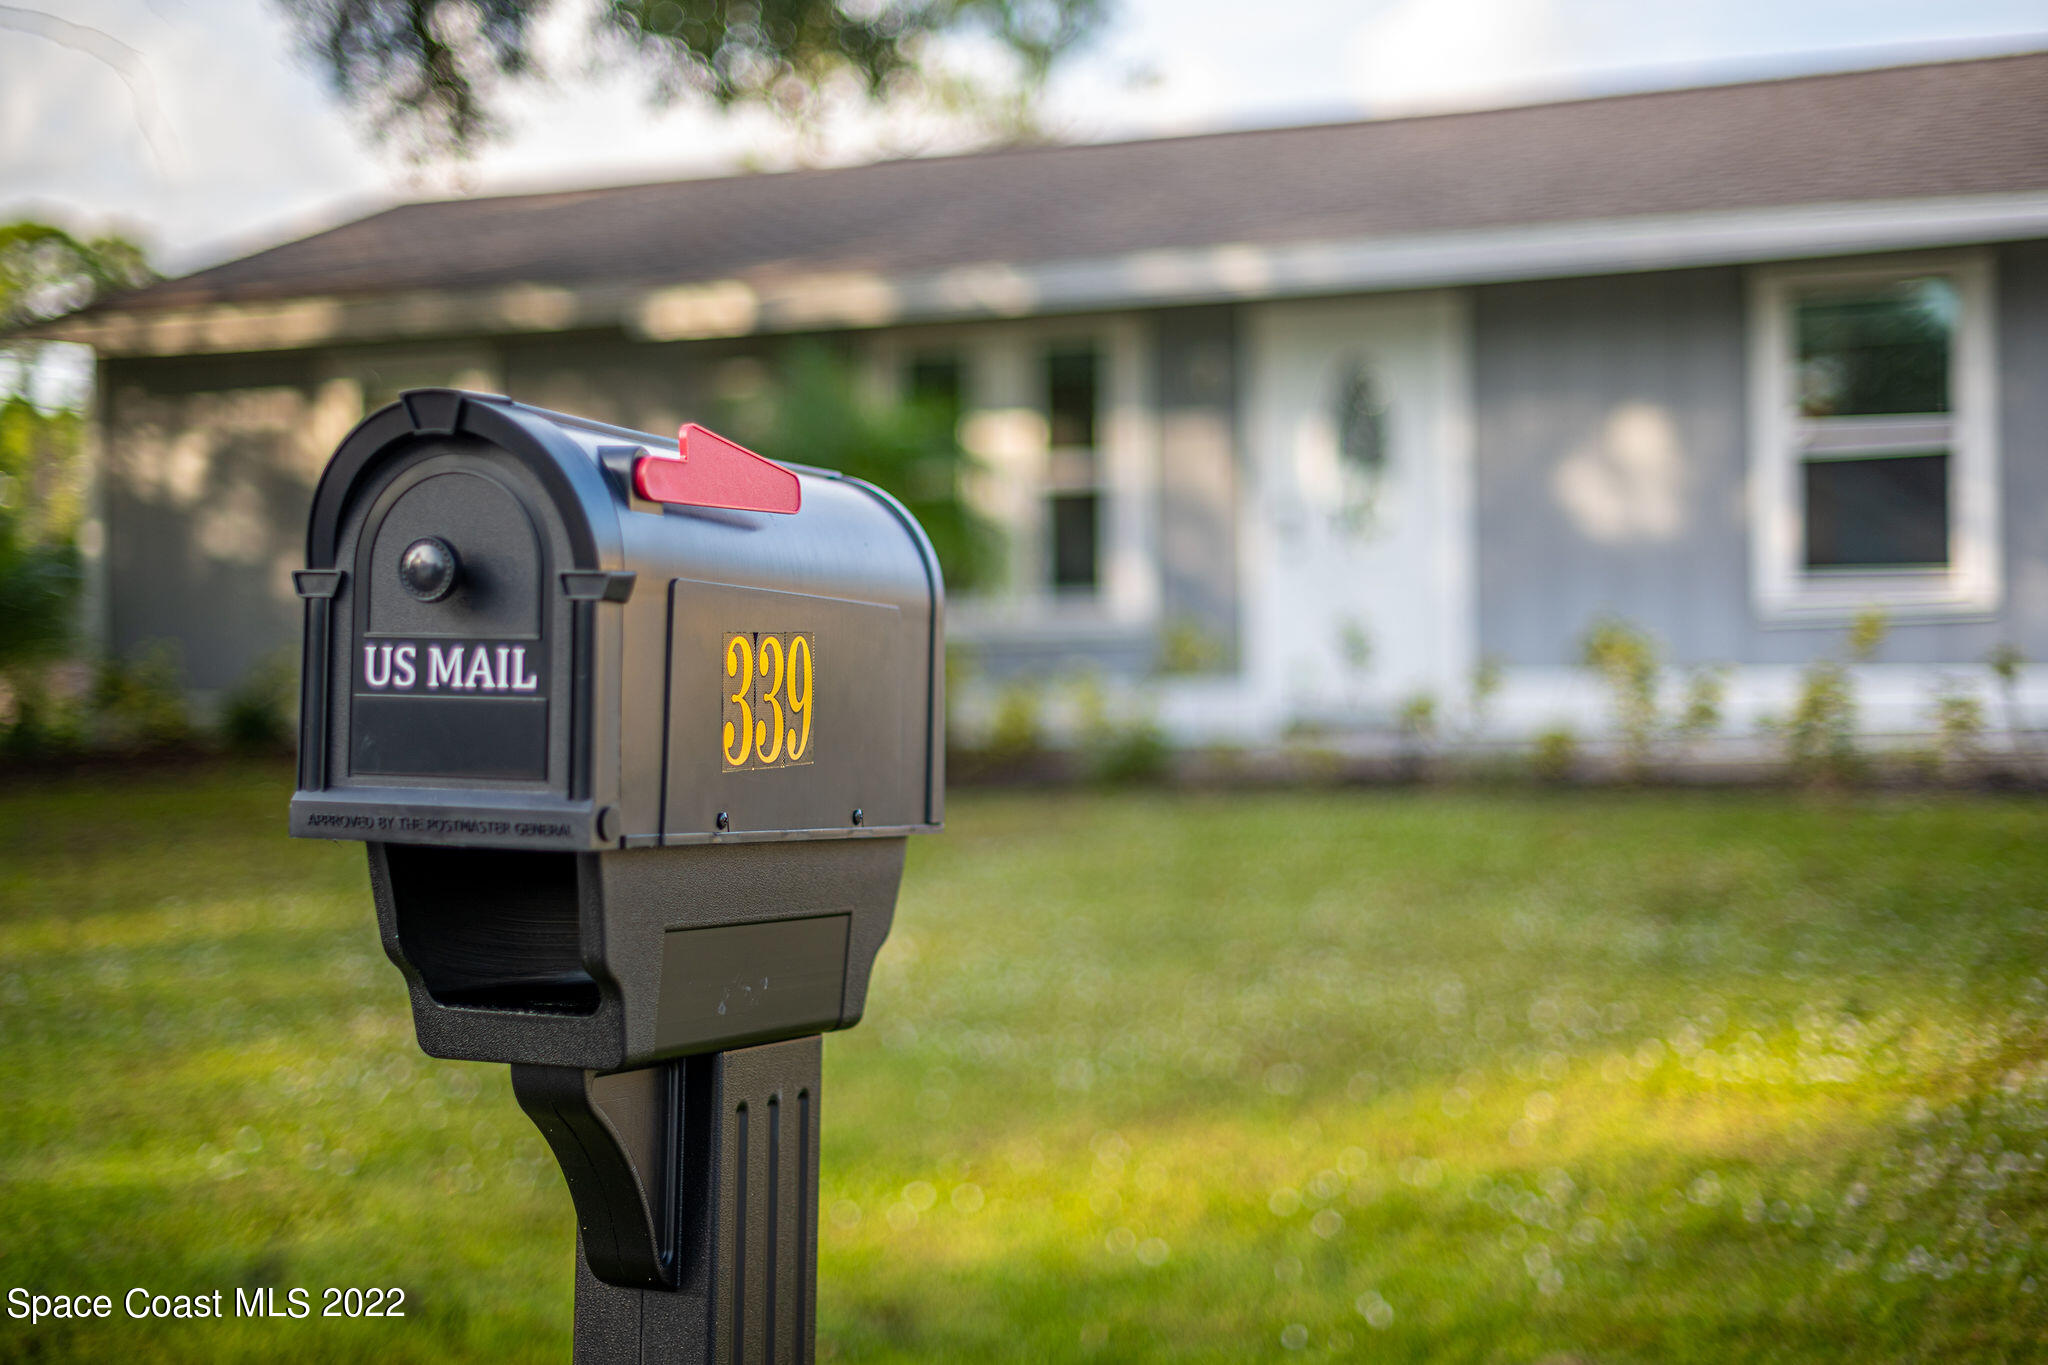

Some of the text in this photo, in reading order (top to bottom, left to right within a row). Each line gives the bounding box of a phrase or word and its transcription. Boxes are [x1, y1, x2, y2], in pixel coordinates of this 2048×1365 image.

[364, 646, 538, 690] US MAIL
[723, 635, 813, 766] 339
[308, 814, 573, 836] APPROVED BY THE POSTMASTER GENERAL
